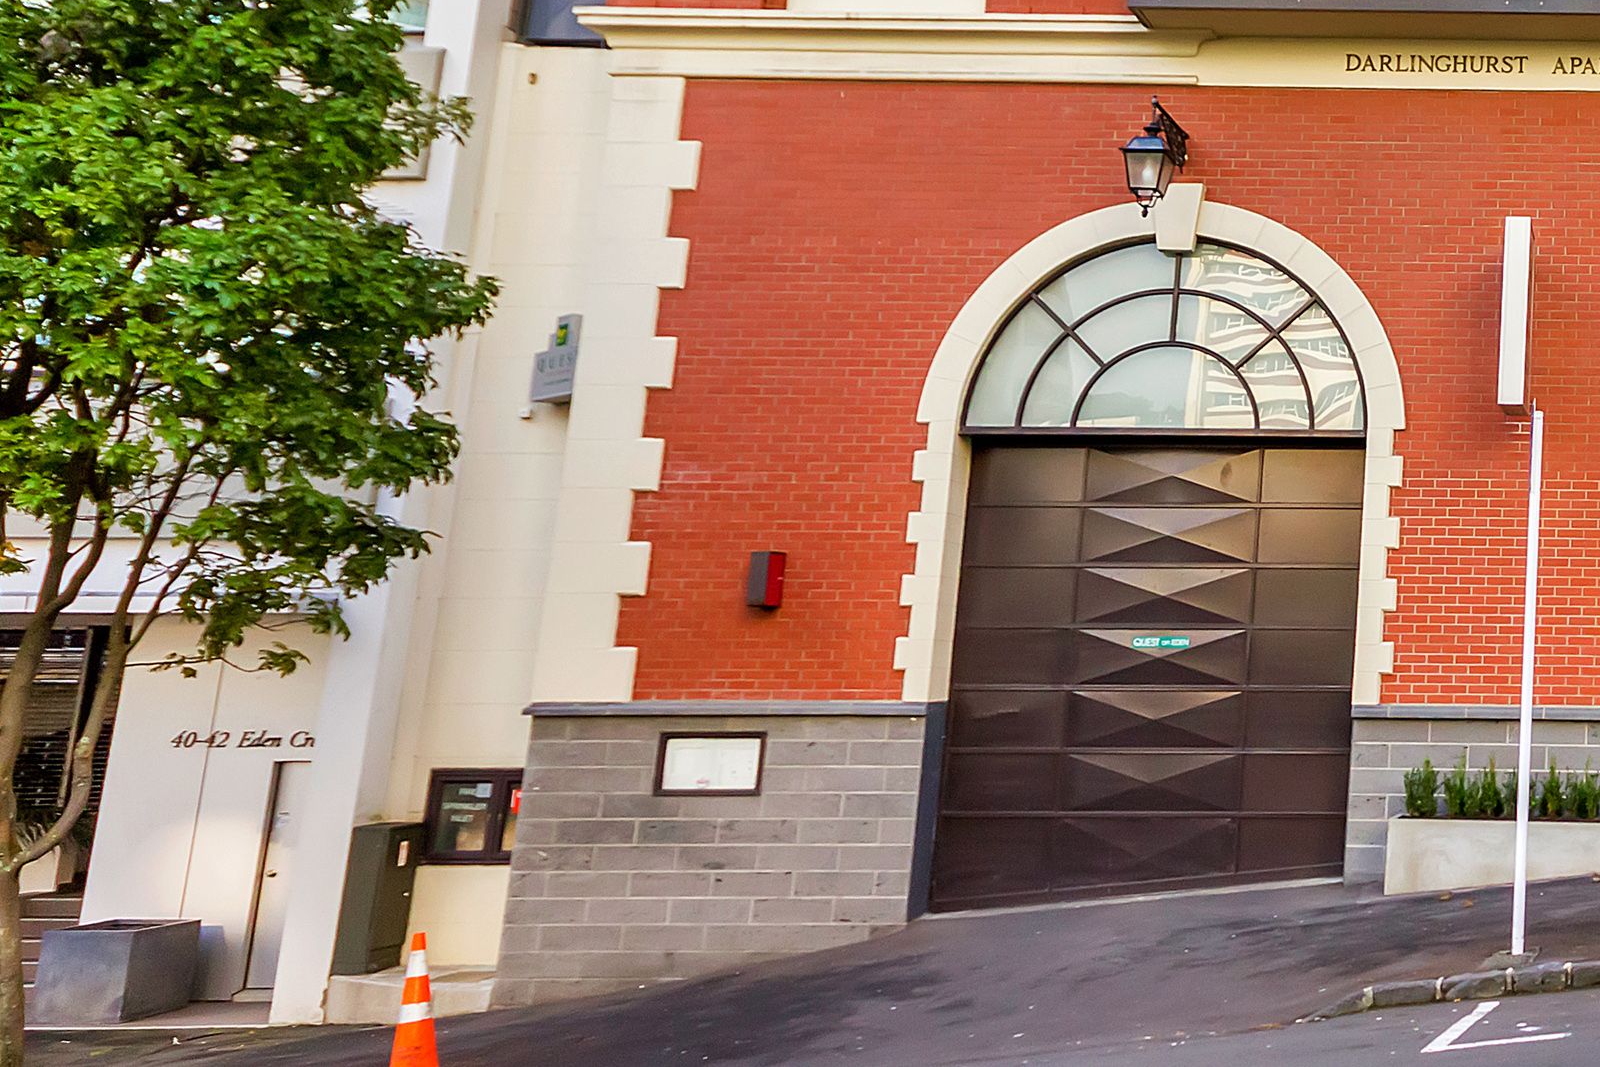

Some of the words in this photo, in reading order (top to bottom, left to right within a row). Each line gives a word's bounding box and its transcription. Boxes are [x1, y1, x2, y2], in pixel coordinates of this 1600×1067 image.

[1344, 52, 1529, 75] DARLINGHURST
[1133, 637, 1160, 646] QUEST
[170, 729, 231, 749] 40-42
[236, 729, 282, 748] Eden
